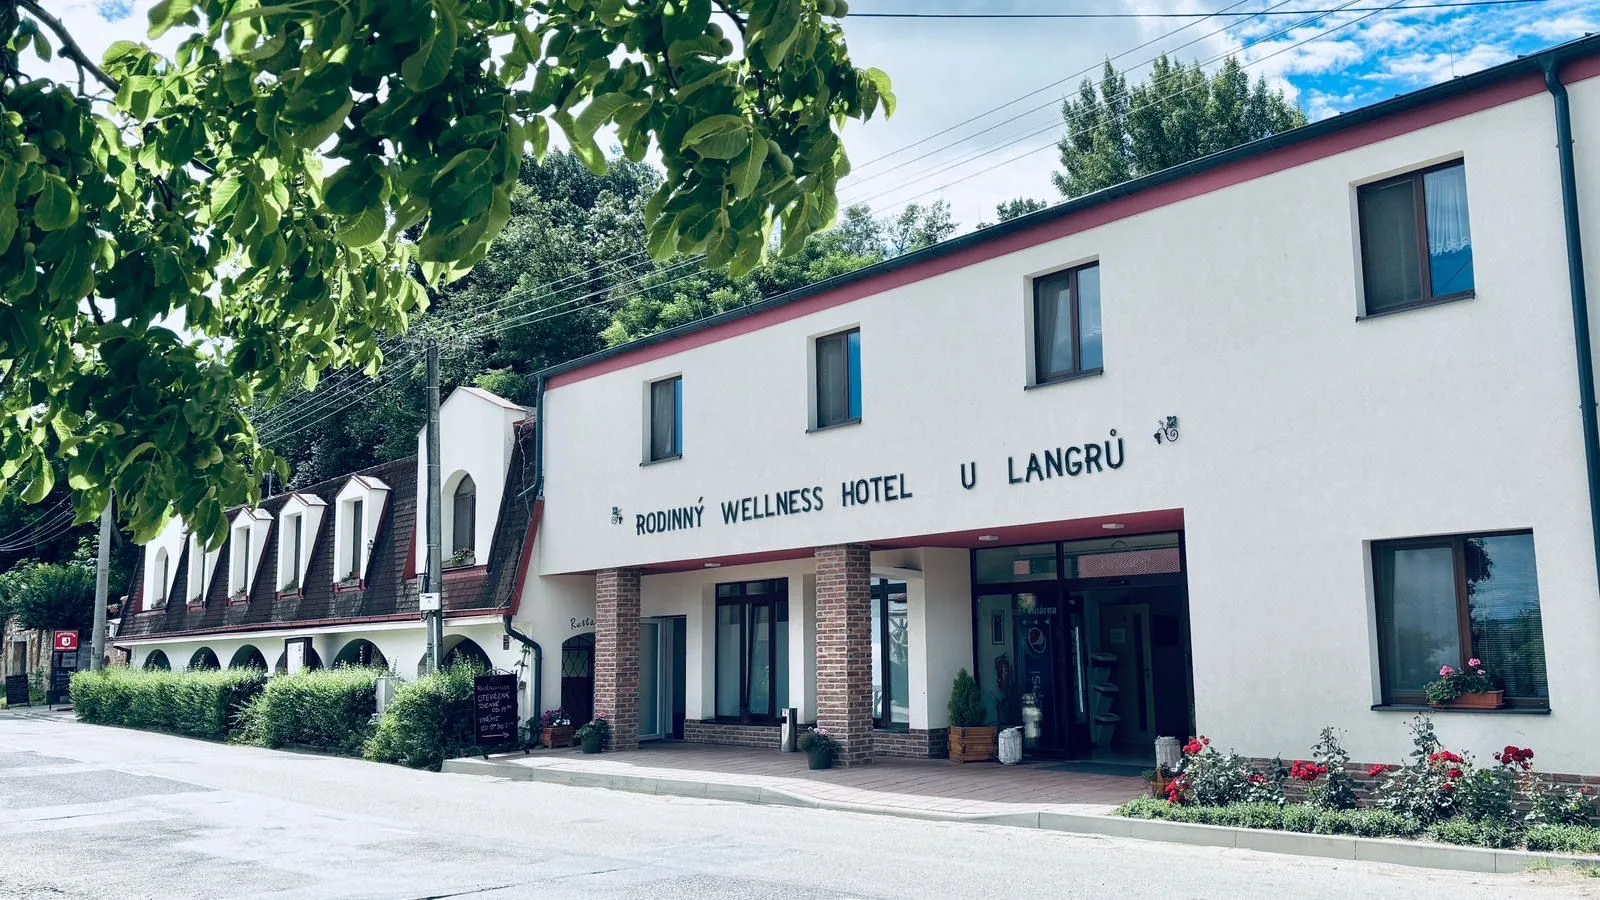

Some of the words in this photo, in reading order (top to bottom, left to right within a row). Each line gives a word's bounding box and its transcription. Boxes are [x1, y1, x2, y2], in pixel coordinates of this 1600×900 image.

[635, 497, 705, 536] RODINNÝ
[720, 487, 824, 525] WELLNESS
[841, 473, 913, 507] HOTEL
[960, 461, 977, 490] U
[1007, 429, 1125, 485] LANGRŮ
[570, 617, 597, 630] Resta
